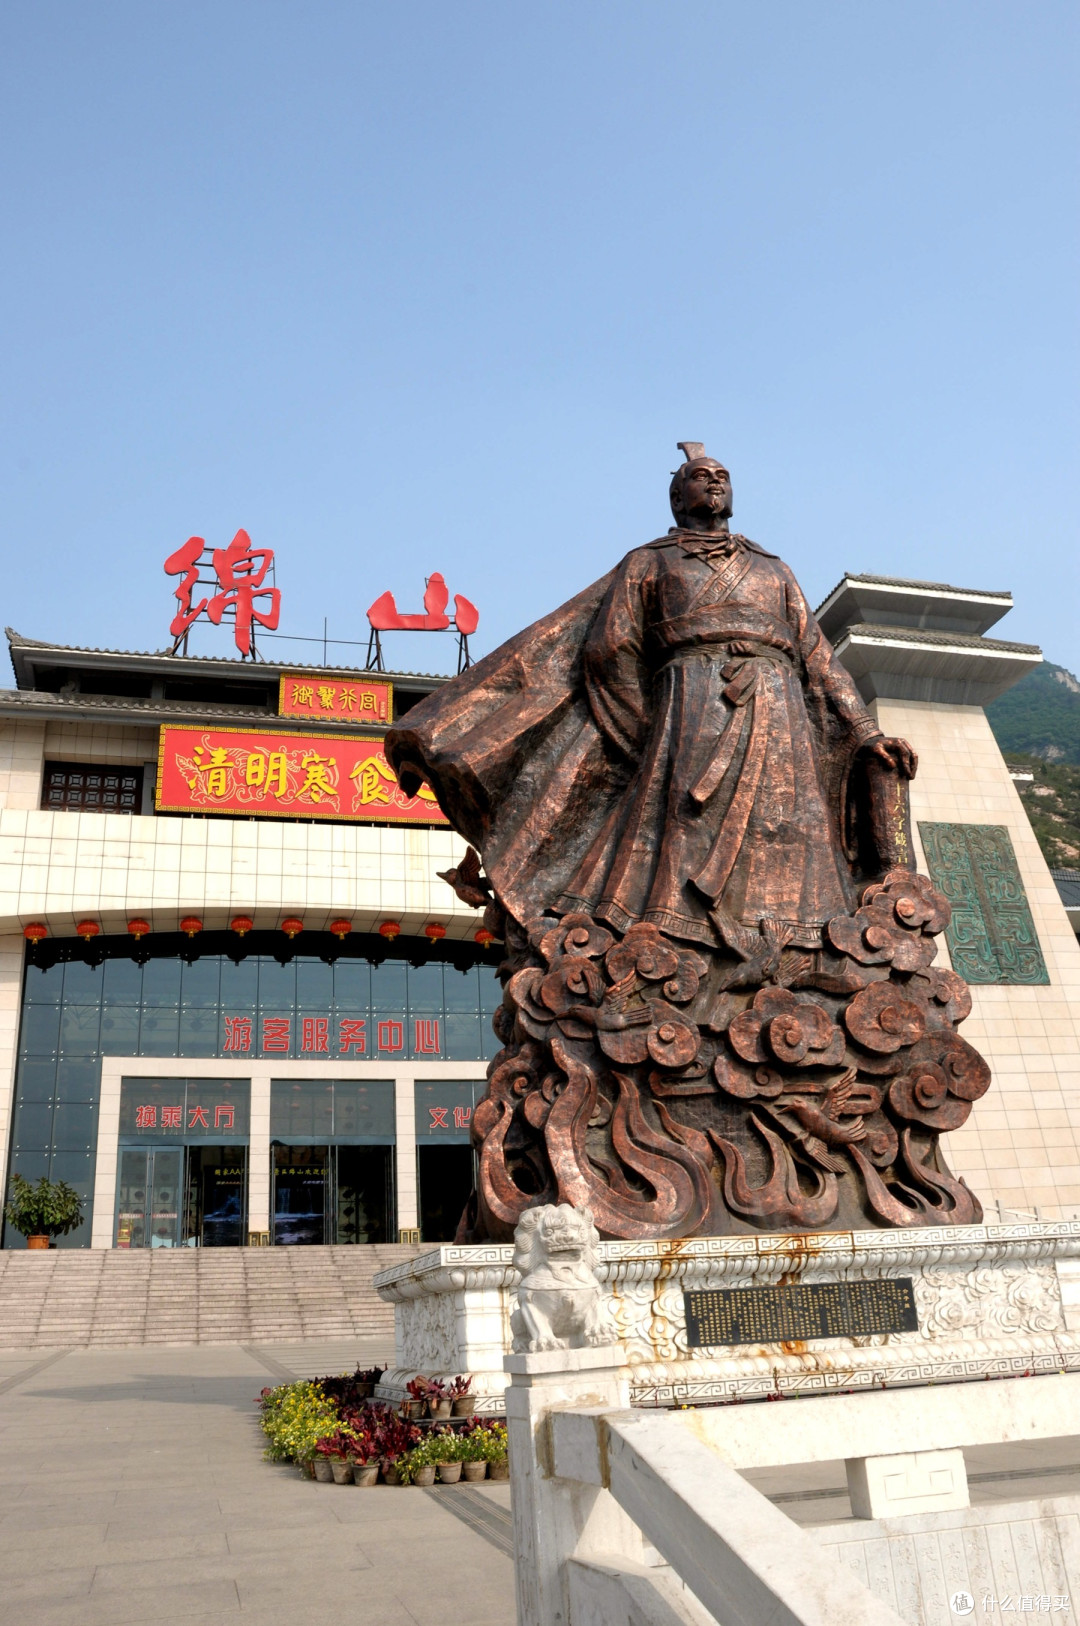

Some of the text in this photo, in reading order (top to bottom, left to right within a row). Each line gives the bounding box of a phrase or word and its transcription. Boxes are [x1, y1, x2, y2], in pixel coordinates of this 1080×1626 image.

[164, 529, 479, 656] 绵山
[191, 746, 438, 804] 清明寒食
[224, 1016, 440, 1053] 游客服务中心
[136, 1105, 235, 1128] 换乘大厅
